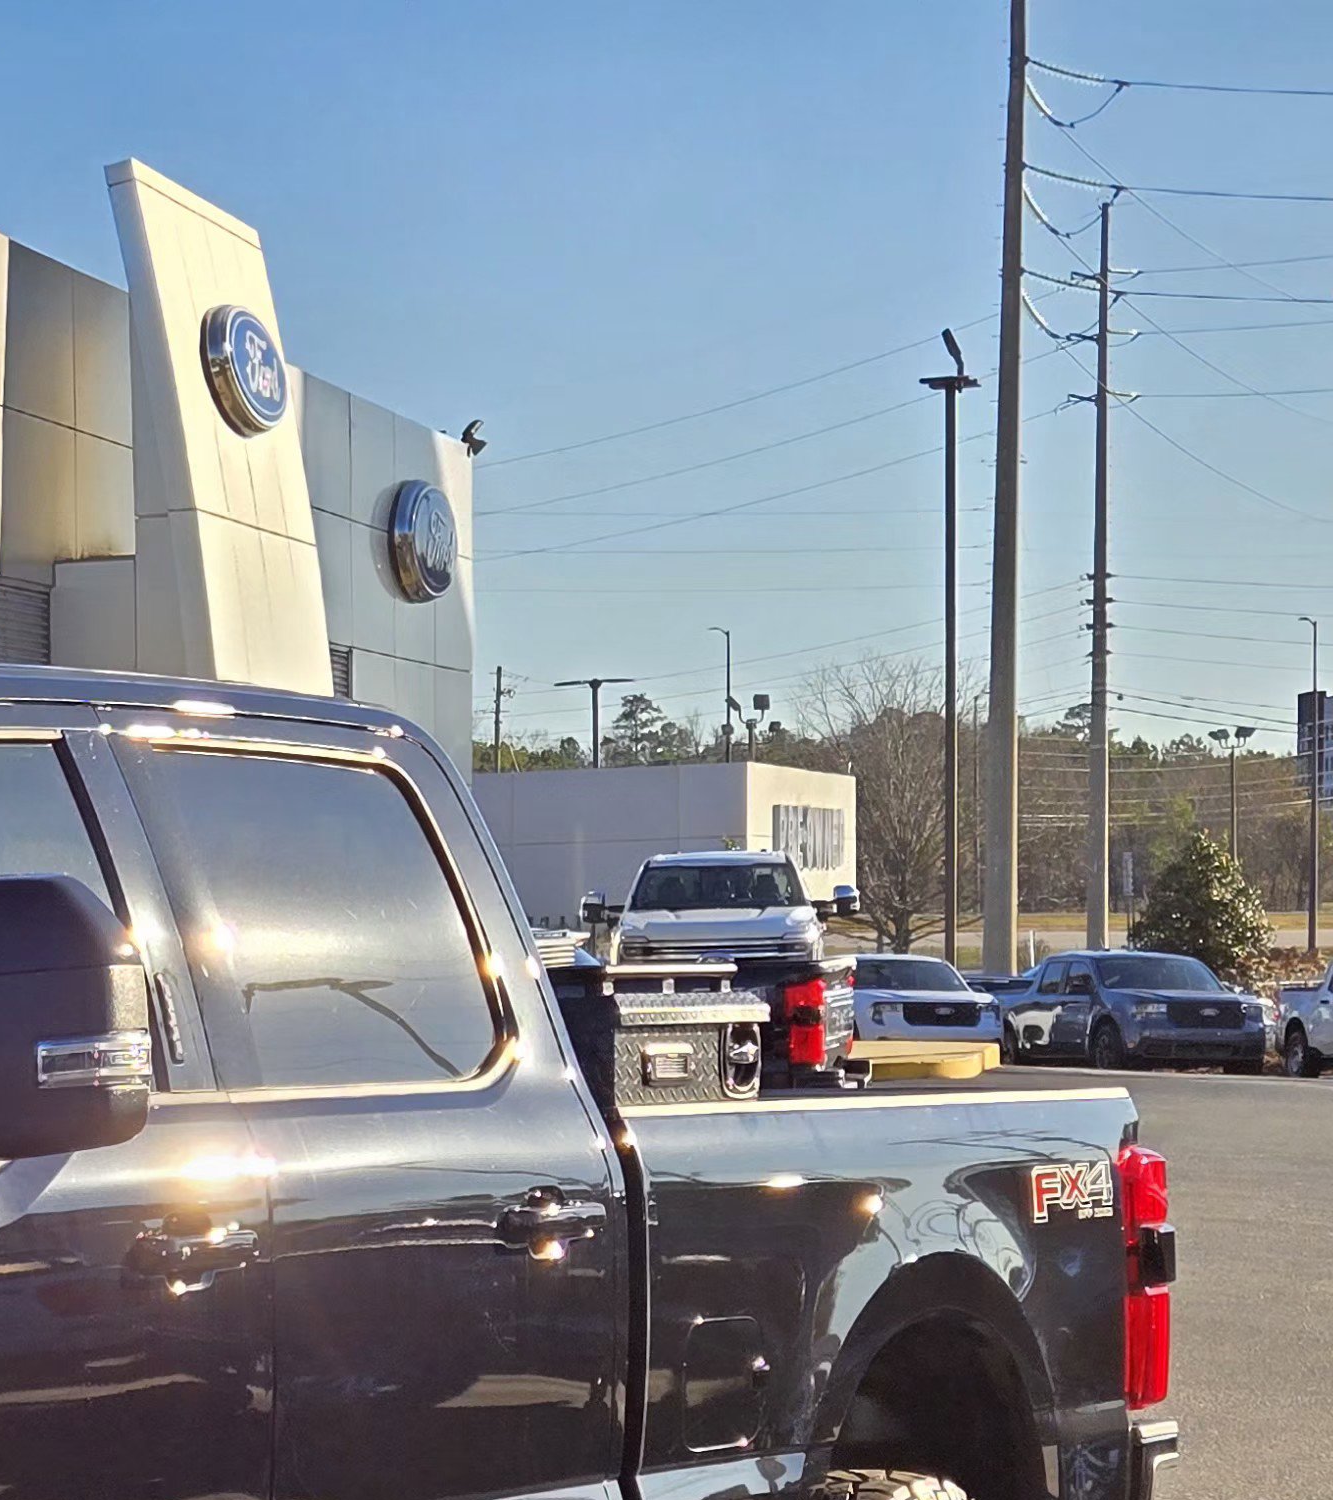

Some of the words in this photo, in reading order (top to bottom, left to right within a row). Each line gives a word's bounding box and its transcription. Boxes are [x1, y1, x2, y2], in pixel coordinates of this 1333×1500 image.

[244, 329, 281, 402] Ford
[426, 511, 456, 572] Ford
[1031, 1161, 1114, 1223] FX4
